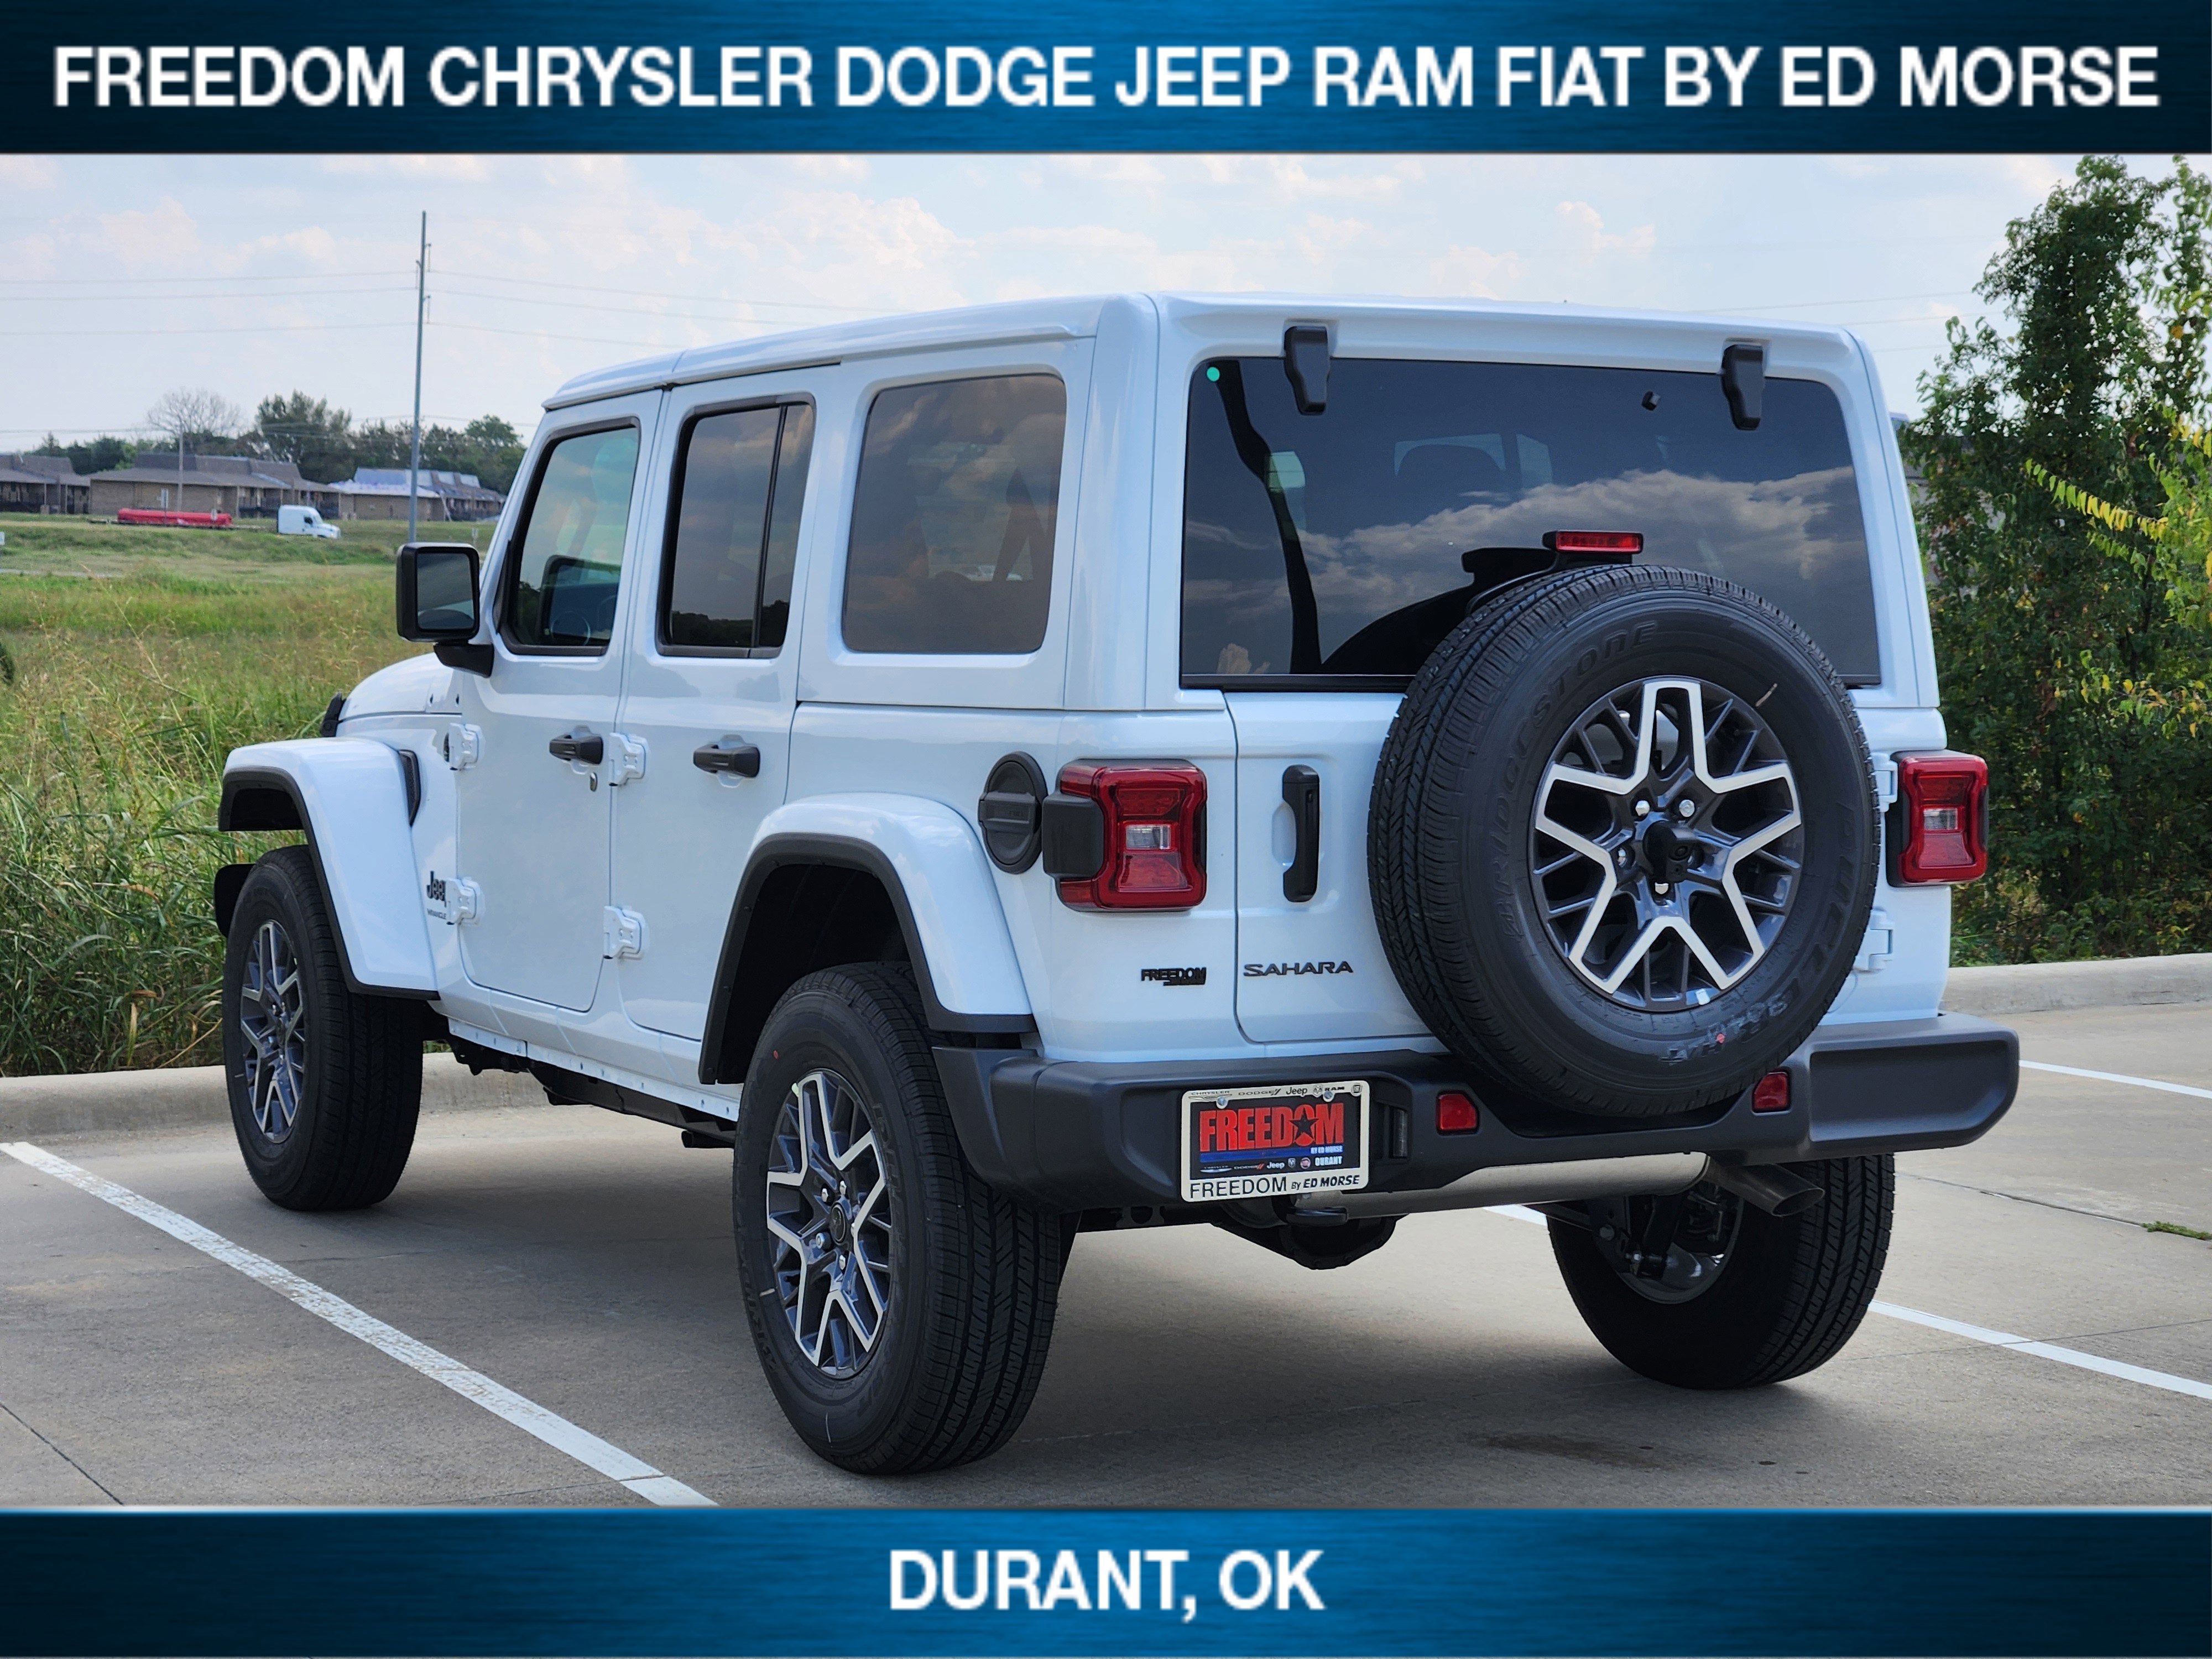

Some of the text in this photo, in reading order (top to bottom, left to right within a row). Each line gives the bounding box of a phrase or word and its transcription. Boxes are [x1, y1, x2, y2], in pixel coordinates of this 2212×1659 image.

[426, 870, 447, 907] Jeep
[1141, 967, 1207, 982] FREEDOM
[1243, 961, 1354, 977] SAHARA
[1286, 1086, 1308, 1095] Jeep
[1199, 1102, 1344, 1152] FREEDOM
[1190, 1175, 1360, 1199] FREEDOM BY ED MORSE
